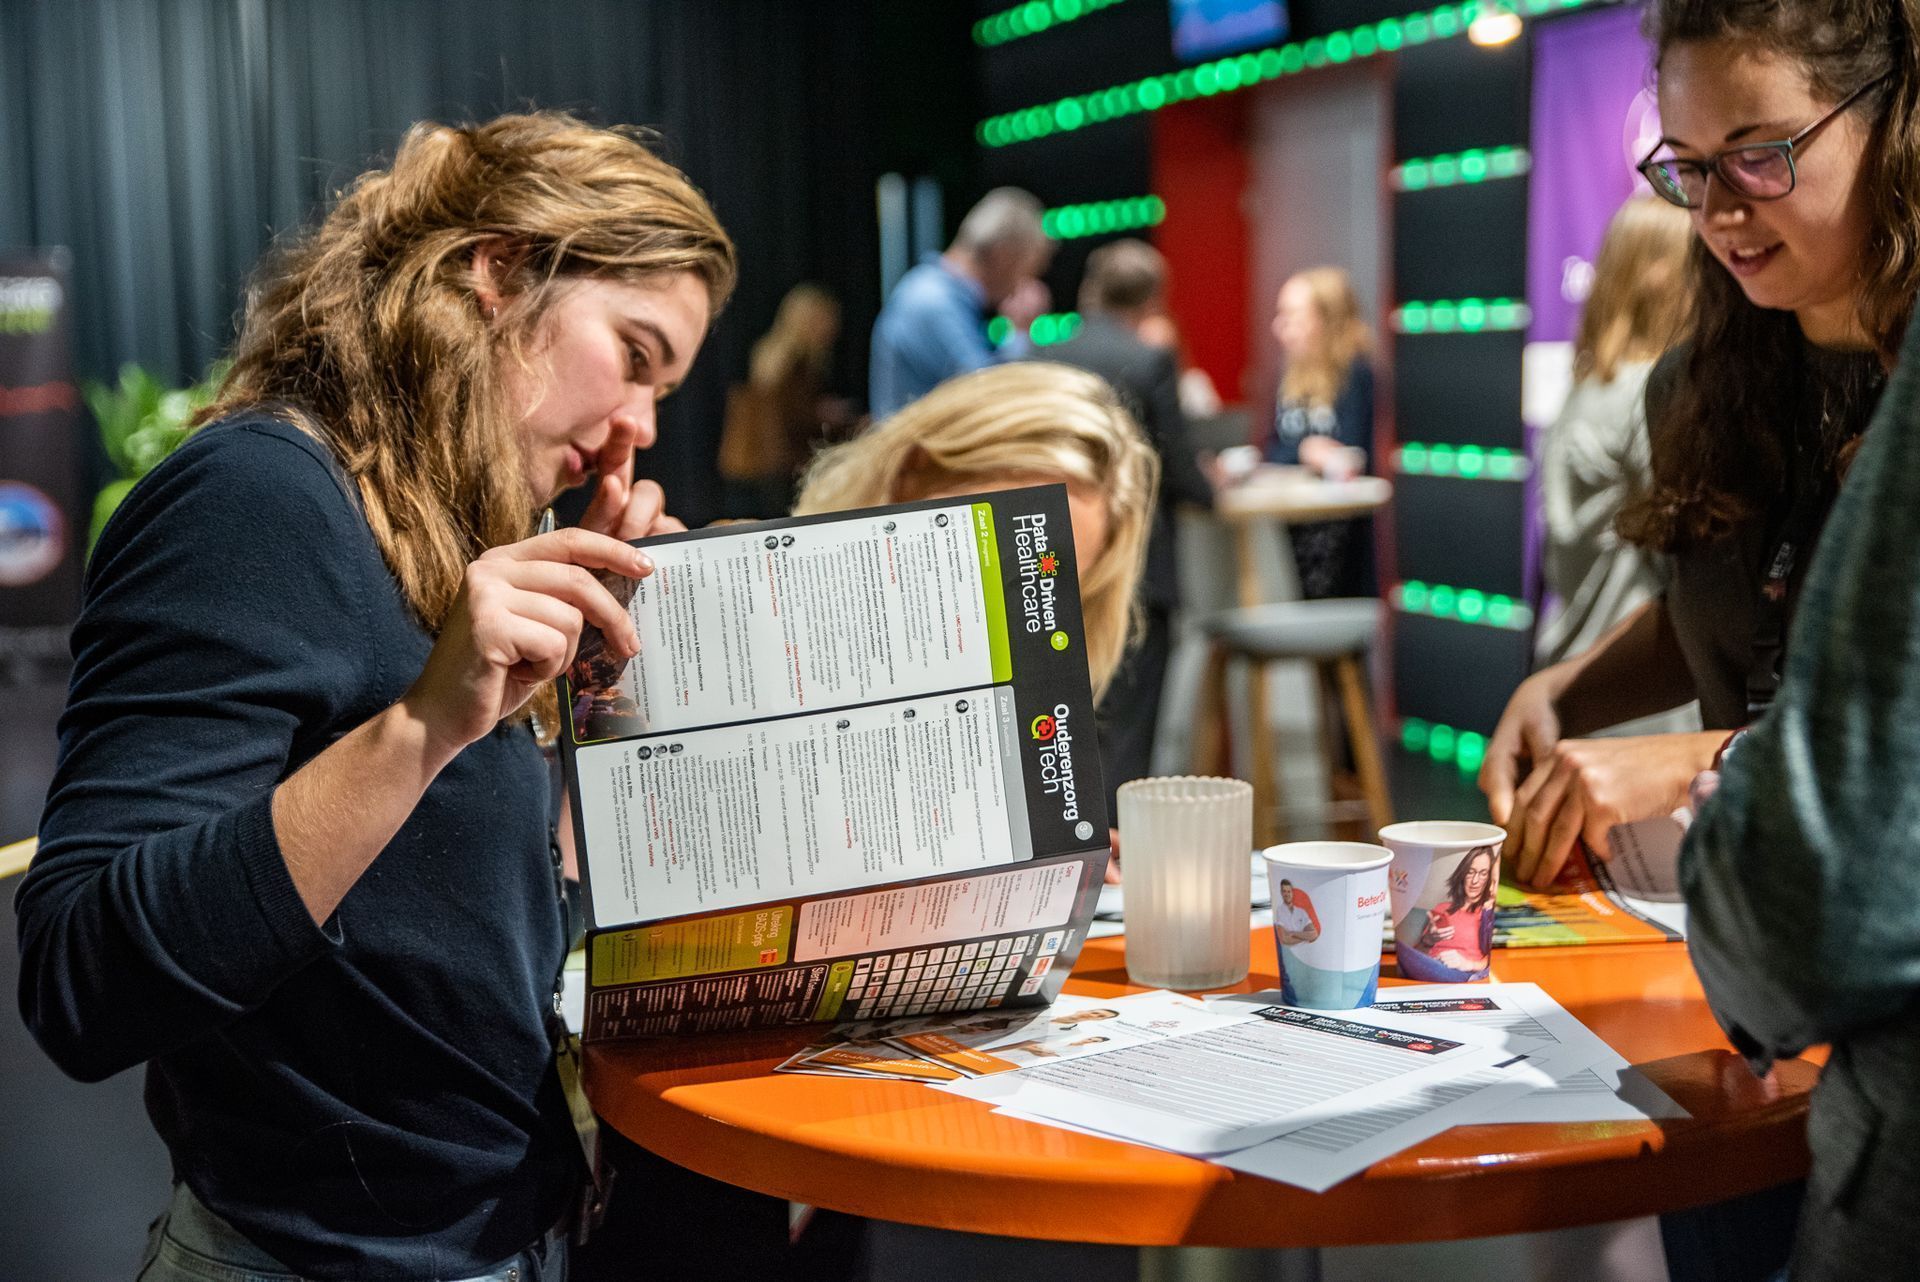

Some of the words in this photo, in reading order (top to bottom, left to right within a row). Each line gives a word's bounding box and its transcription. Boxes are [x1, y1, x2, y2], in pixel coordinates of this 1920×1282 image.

[977, 509, 987, 529] Zaal
[1013, 515, 1040, 631] Healthcare
[1031, 513, 1047, 552] Data
[1039, 578, 1055, 630] Driven
[1000, 695, 1008, 715] Zaal
[1039, 739, 1062, 792] Tech
[1052, 704, 1077, 819] Ouderenzorg
